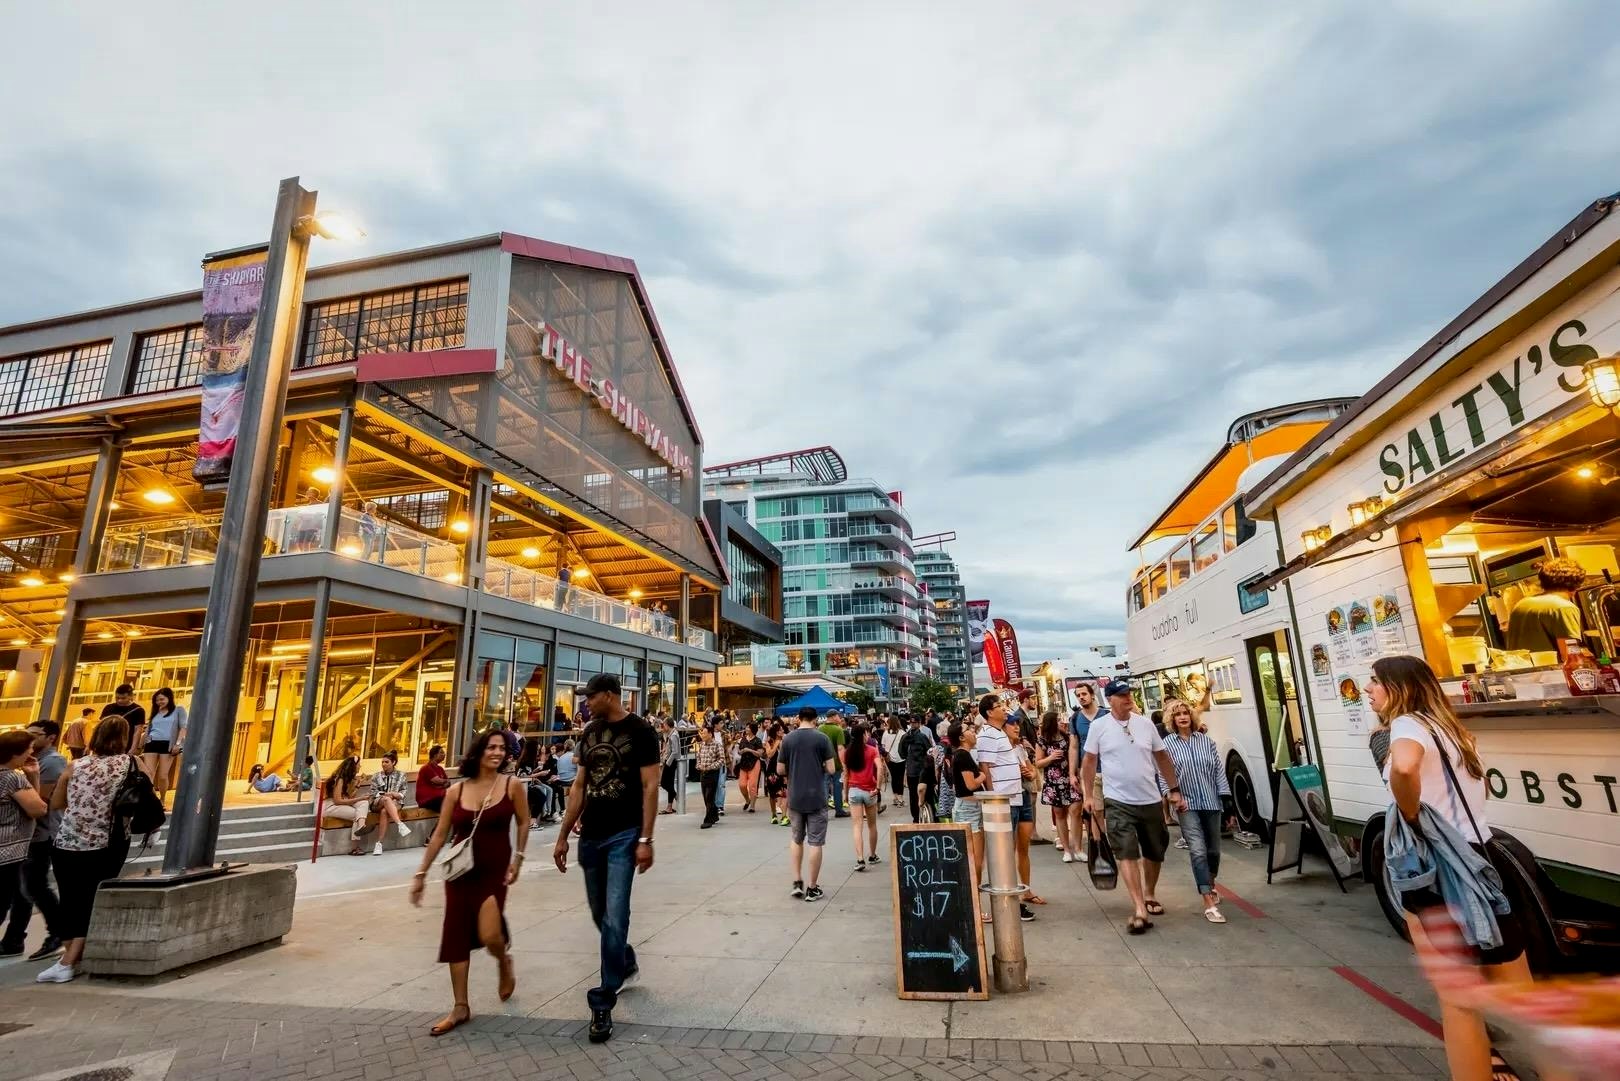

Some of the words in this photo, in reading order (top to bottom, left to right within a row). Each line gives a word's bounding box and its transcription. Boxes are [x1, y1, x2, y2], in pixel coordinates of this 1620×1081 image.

[222, 266, 265, 286] SHIPYAR
[538, 321, 593, 394] THE
[1379, 319, 1600, 496] SALTY'S
[1003, 639, 1018, 669] Cannoli
[1485, 767, 1618, 814] OBST
[900, 835, 962, 863] CRAB
[904, 864, 958, 888] ROLL
[912, 891, 951, 919] $17
